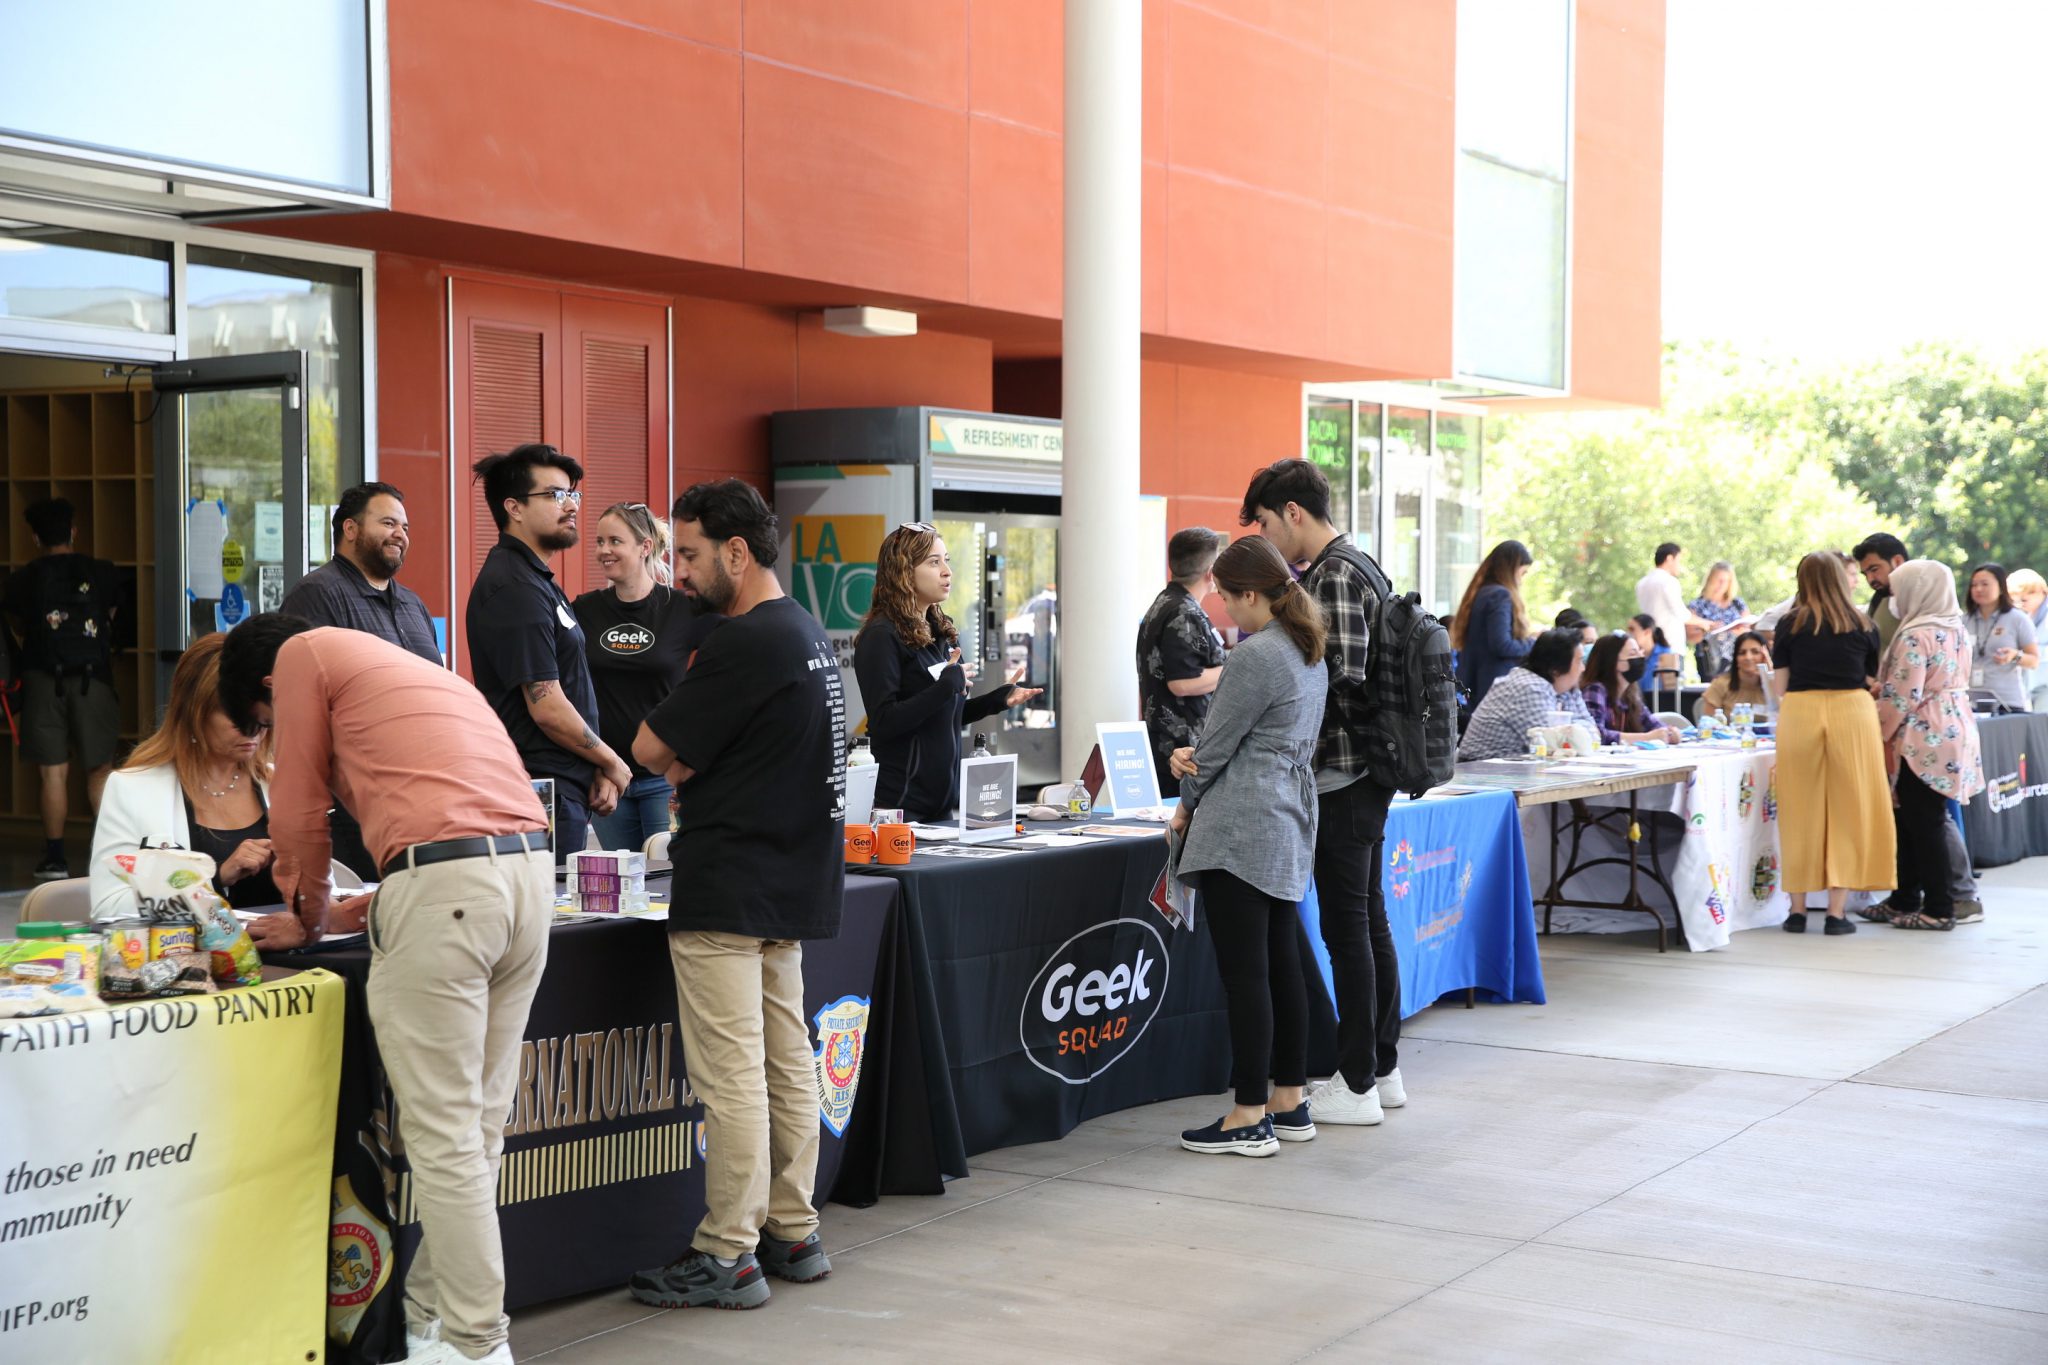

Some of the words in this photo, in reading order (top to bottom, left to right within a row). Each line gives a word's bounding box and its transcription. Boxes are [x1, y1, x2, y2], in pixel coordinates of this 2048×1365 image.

[963, 428, 1039, 449] REFRESHMENT
[1309, 442, 1346, 467] OWLS
[796, 522, 842, 563] LA
[607, 630, 649, 643] Geek
[611, 642, 641, 650] SQUAD
[979, 789, 1002, 801] HIRING!
[1042, 948, 1154, 1023] Geek
[108, 1001, 198, 1040] FOOD
[214, 983, 316, 1026] PANTRY
[827, 1016, 846, 1030] PRIVATE
[1058, 1016, 1127, 1056] SQUAD
[502, 1022, 675, 1138] RNATIONAL
[4, 1160, 84, 1195] those
[90, 1149, 117, 1178] in
[125, 1132, 198, 1172] need
[0, 1193, 132, 1243] mmunity
[0, 1294, 90, 1332] IFP.org
